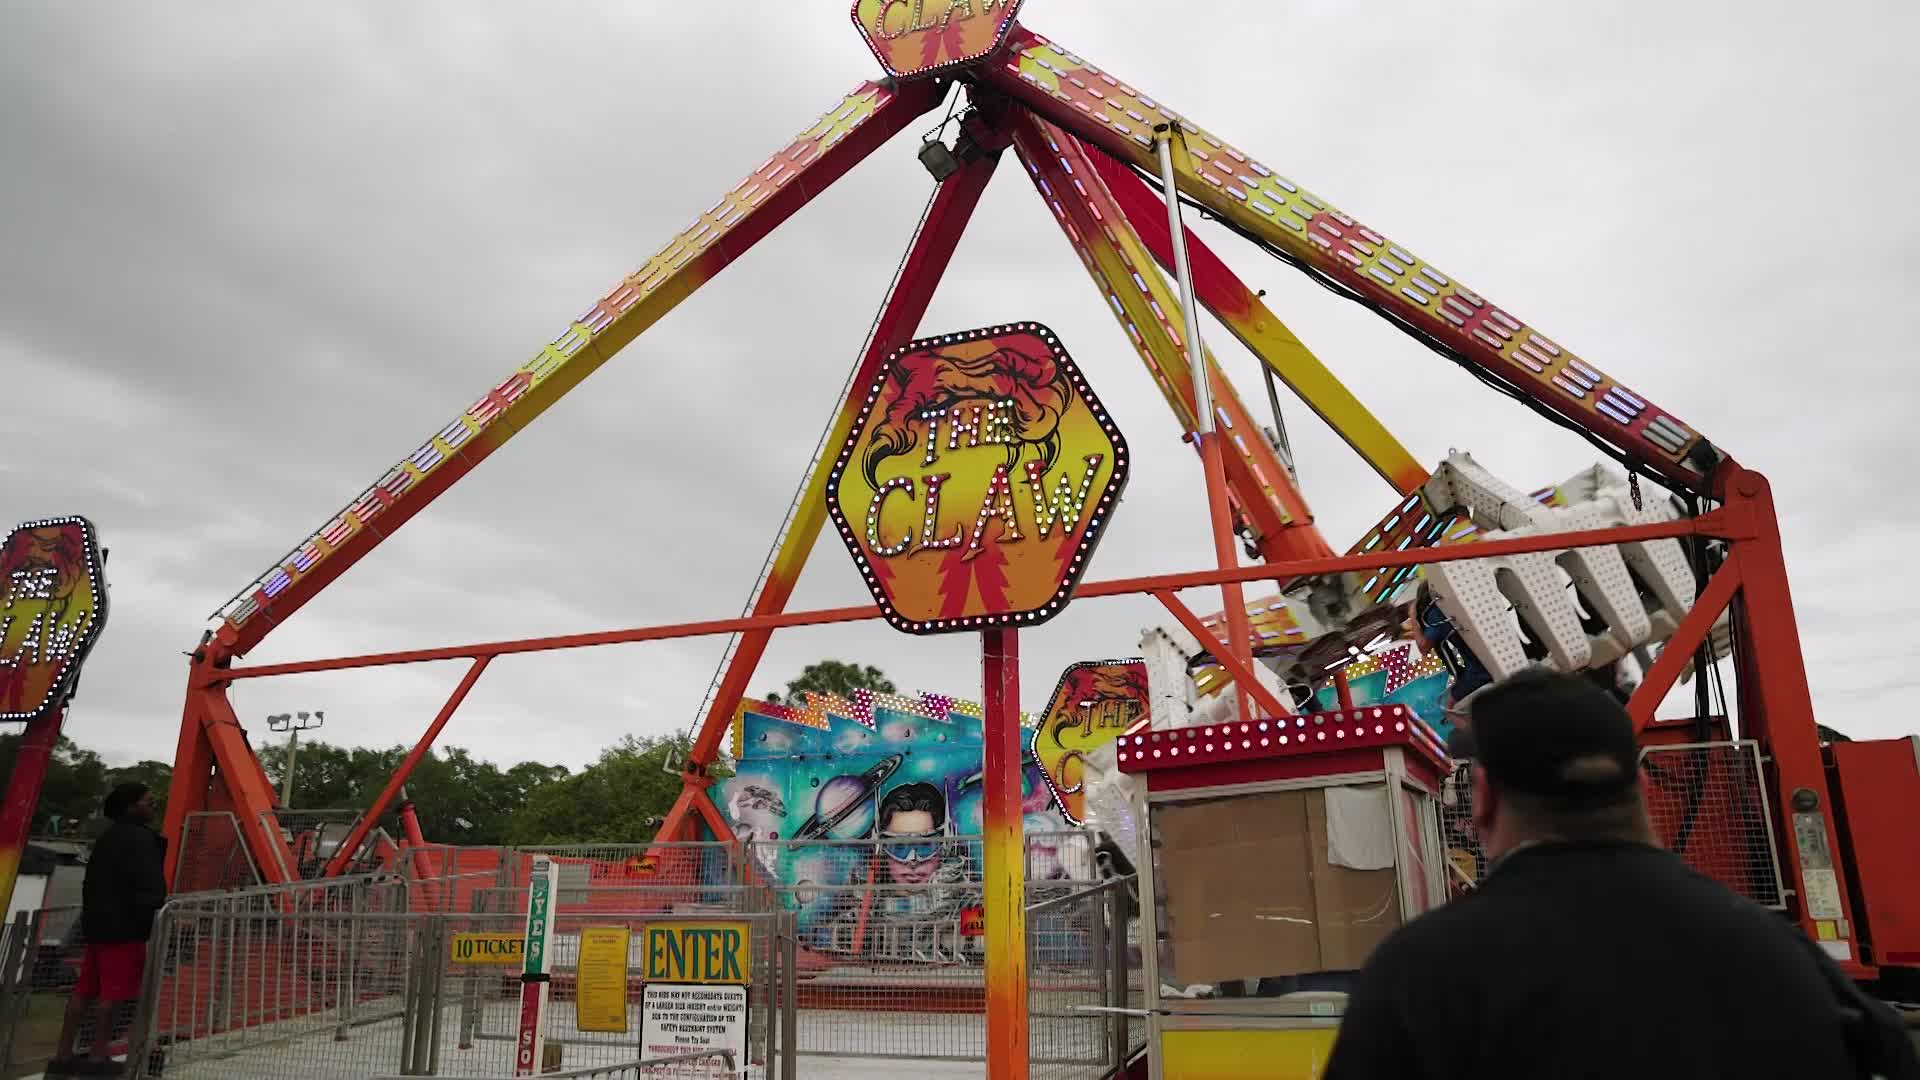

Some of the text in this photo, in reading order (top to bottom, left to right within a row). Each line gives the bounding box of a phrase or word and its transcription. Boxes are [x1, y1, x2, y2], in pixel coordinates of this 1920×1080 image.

[919, 399, 1015, 468] THE
[864, 453, 1104, 562] CLAW
[5, 568, 58, 608] THE
[1080, 698, 1139, 738] THE
[456, 939, 473, 959] 10
[648, 929, 742, 979] ENTER
